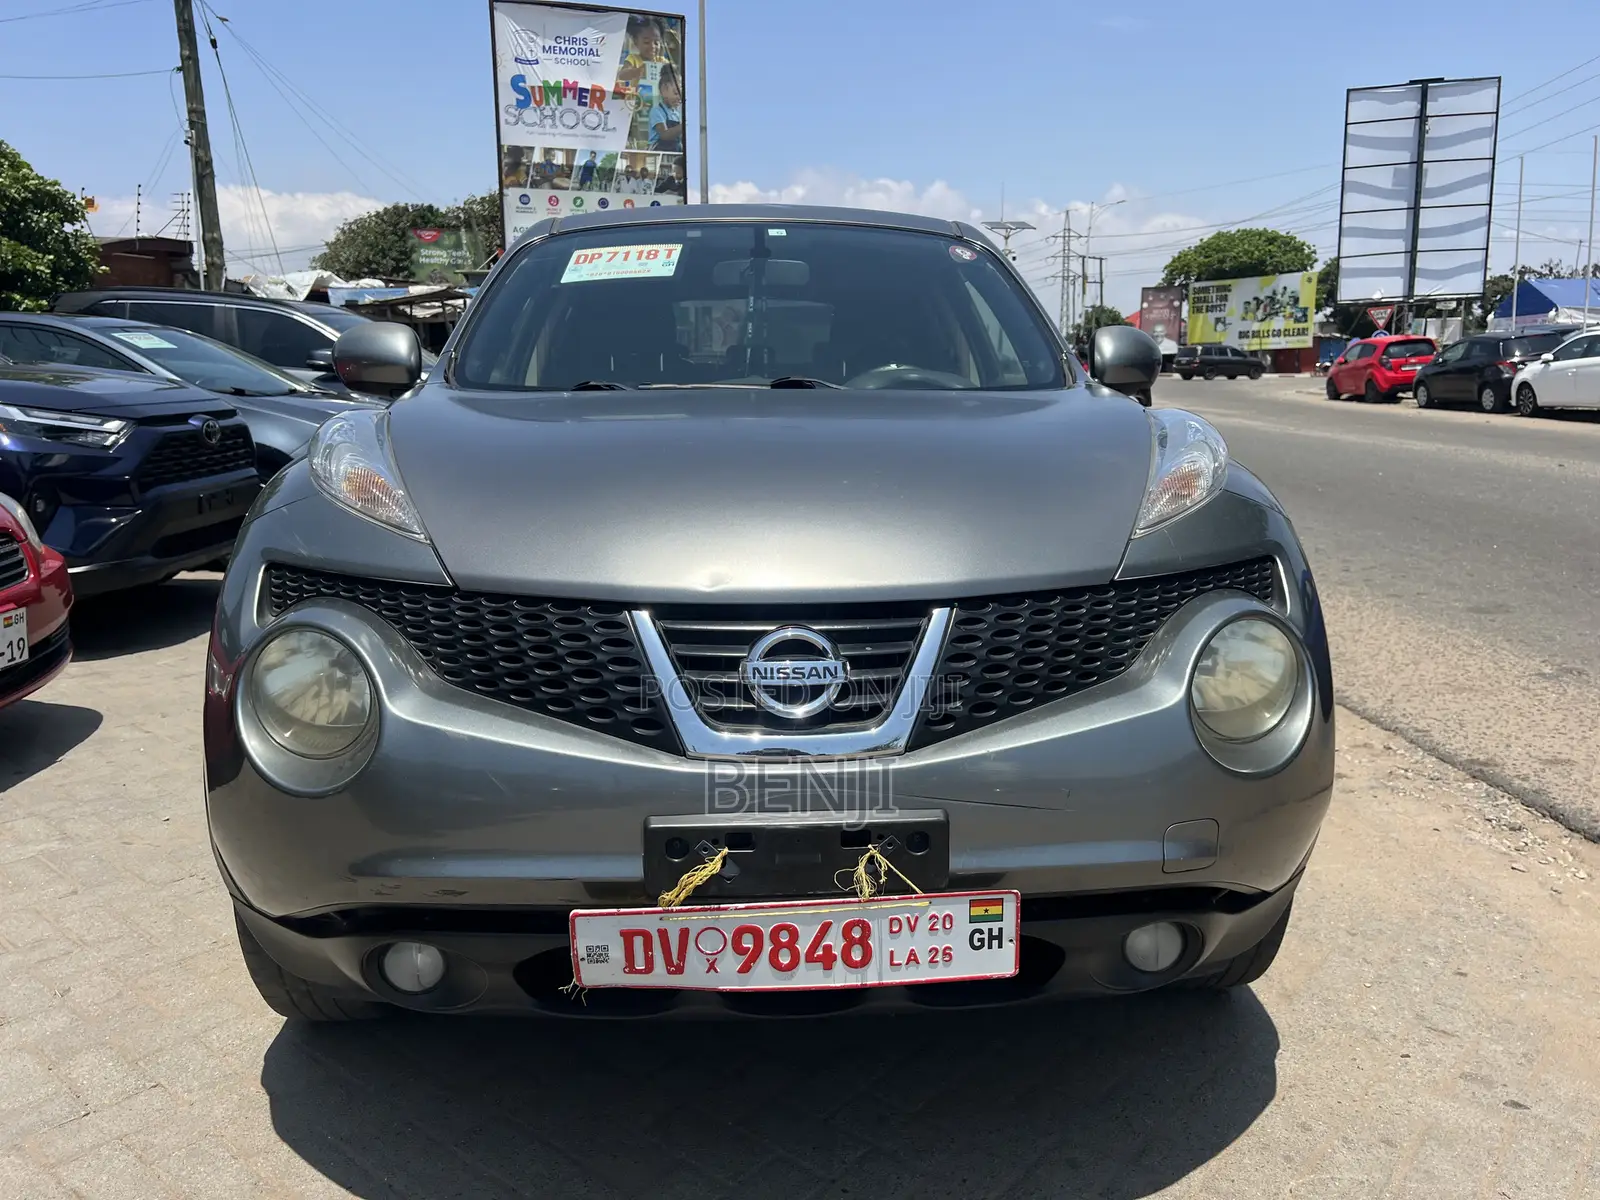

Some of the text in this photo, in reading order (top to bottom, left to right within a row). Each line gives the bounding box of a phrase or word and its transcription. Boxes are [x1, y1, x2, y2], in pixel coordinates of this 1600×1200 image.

[554, 35, 588, 46] CHRIS
[542, 45, 600, 57] MEMORIAL
[554, 57, 590, 66] SCHOOL
[504, 104, 617, 132] SCHOOL
[420, 248, 447, 257] Strong
[419, 257, 449, 266] Healthy
[1192, 294, 1228, 304] SMALL FOR
[1192, 304, 1204, 314] THE
[1238, 330, 1250, 339] BIG
[1252, 328, 1270, 338] BILLS
[1272, 328, 1281, 337] GO
[14, 612, 24, 624] GH
[751, 665, 839, 680] NISSAN
[889, 912, 954, 934] DV 20
[968, 927, 1004, 951] GH
[619, 927, 689, 976] DV
[731, 918, 873, 974] 9848
[889, 947, 921, 967] LA
